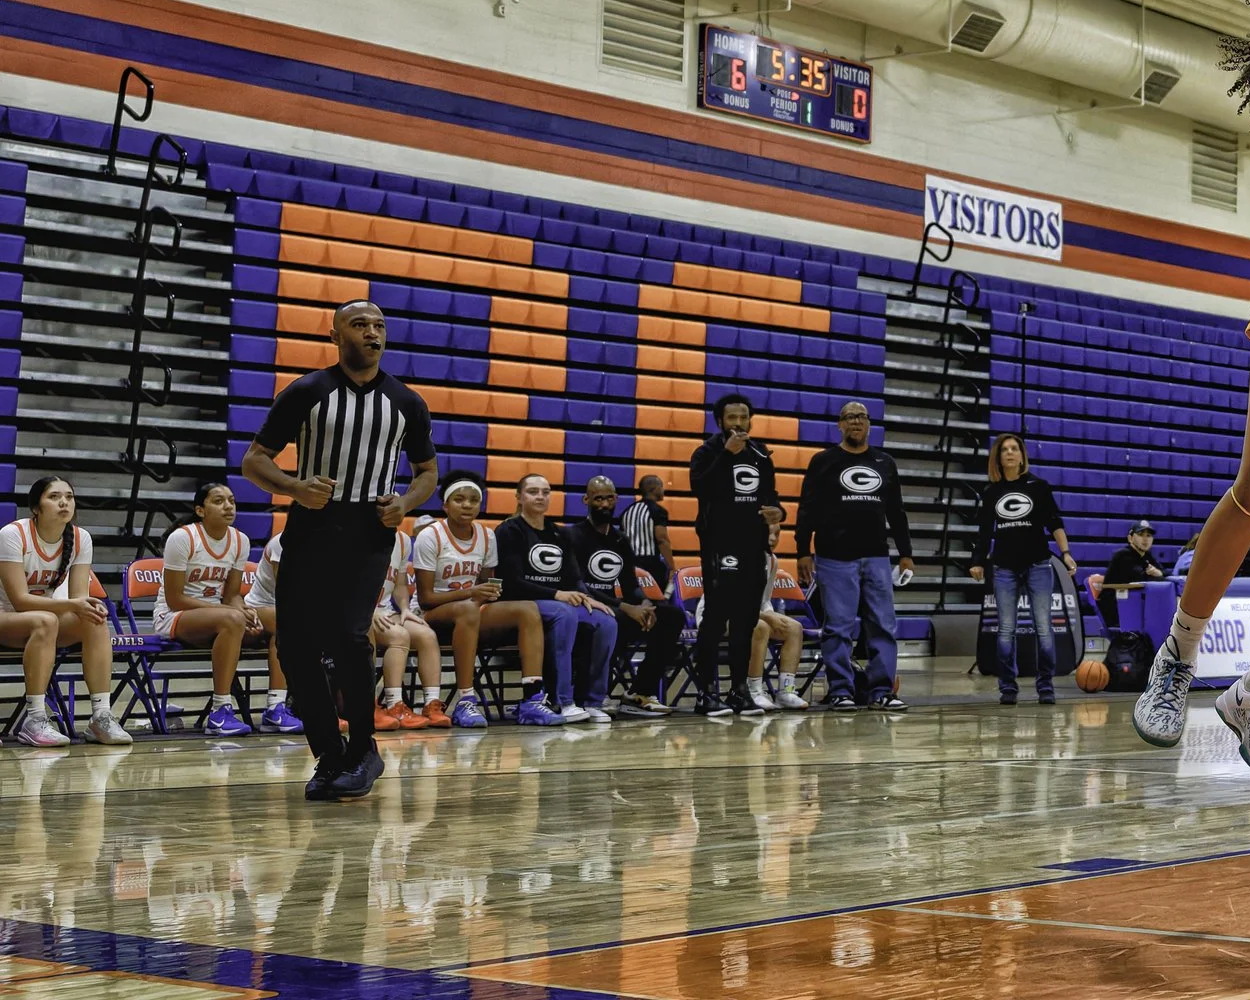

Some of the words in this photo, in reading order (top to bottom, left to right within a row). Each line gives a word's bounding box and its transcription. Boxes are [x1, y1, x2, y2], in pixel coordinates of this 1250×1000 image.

[714, 33, 744, 53] HOME
[730, 58, 747, 92] 6
[771, 48, 828, 91] 5:35
[834, 63, 870, 86] VISITOR
[724, 93, 750, 110] BONUS
[770, 96, 797, 113] PERIOD
[853, 88, 867, 120] 0
[806, 101, 812, 124] 1
[830, 118, 856, 133] BONUS
[927, 186, 1061, 250] VISITORS
[998, 521, 1032, 529] BASKETBALL
[134, 570, 163, 583] GOR
[683, 576, 703, 587] GOR
[111, 637, 144, 646] GAELS
